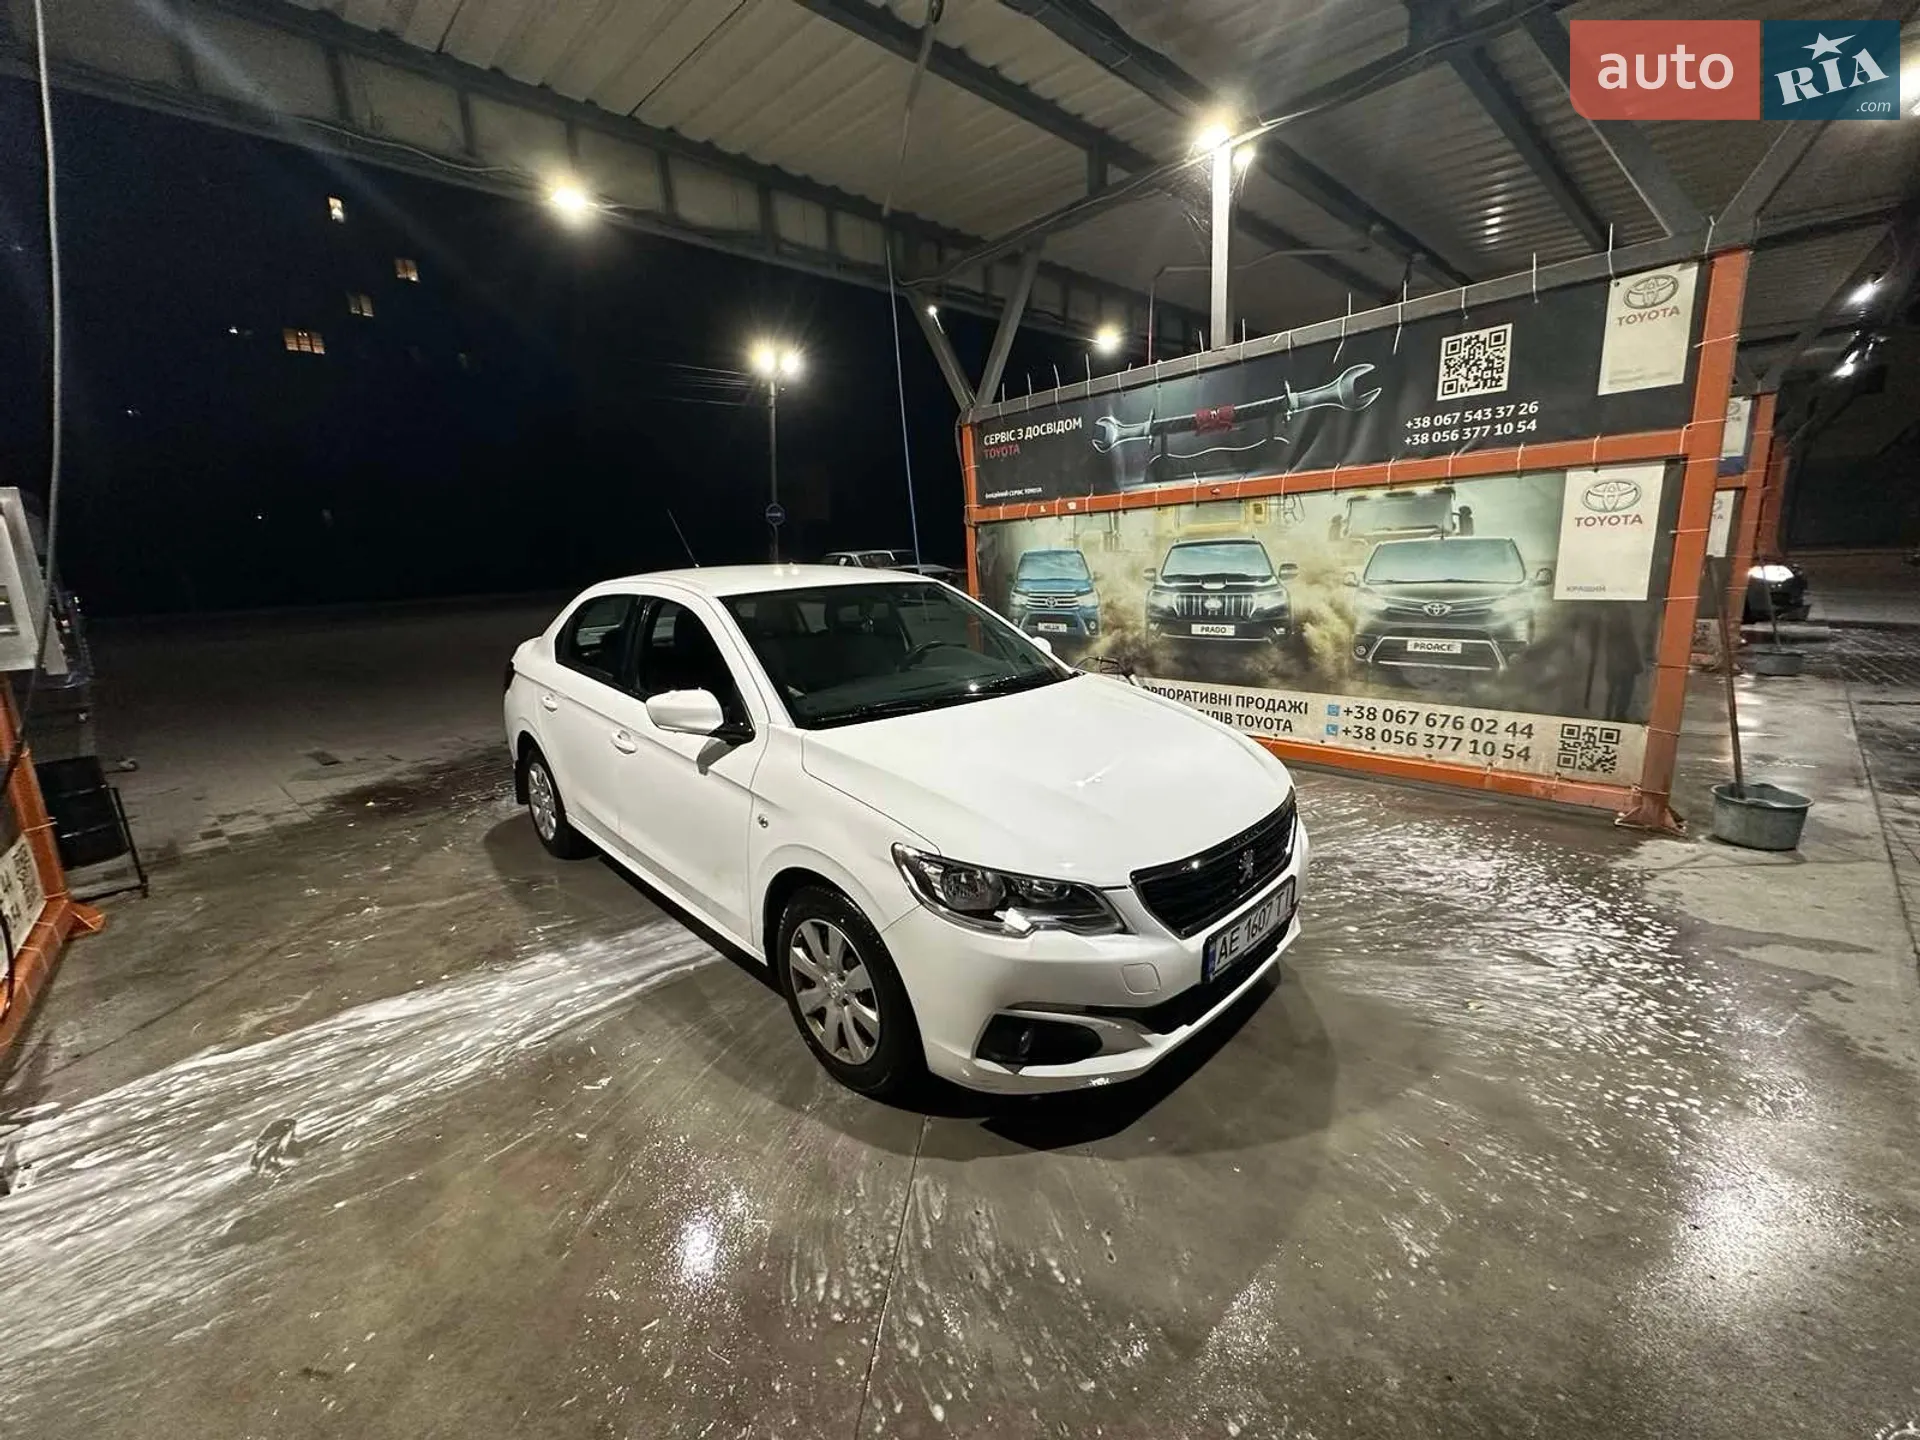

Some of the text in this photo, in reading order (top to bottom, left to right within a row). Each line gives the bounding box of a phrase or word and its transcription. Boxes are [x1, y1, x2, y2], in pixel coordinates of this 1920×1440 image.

[1617, 306, 1680, 326] TOYOTA
[1406, 401, 1539, 429] +38 067 543 37 26
[984, 429, 1016, 446] СЕРВІС
[1024, 416, 1083, 440] ДОСВІДОМ
[1404, 419, 1537, 445] +38 056 377 10 54
[984, 443, 1020, 459] TOYOTA
[1575, 514, 1643, 528] TOYOTA
[1236, 695, 1308, 715] ПРОДАЖІ
[1236, 713, 1293, 733] TOYOTA
[1343, 705, 1534, 740] +38 067 676 02 44
[1342, 725, 1531, 762] +38 056 377 10 54
[1217, 926, 1240, 965] AE
[1244, 901, 1273, 943] 1607
